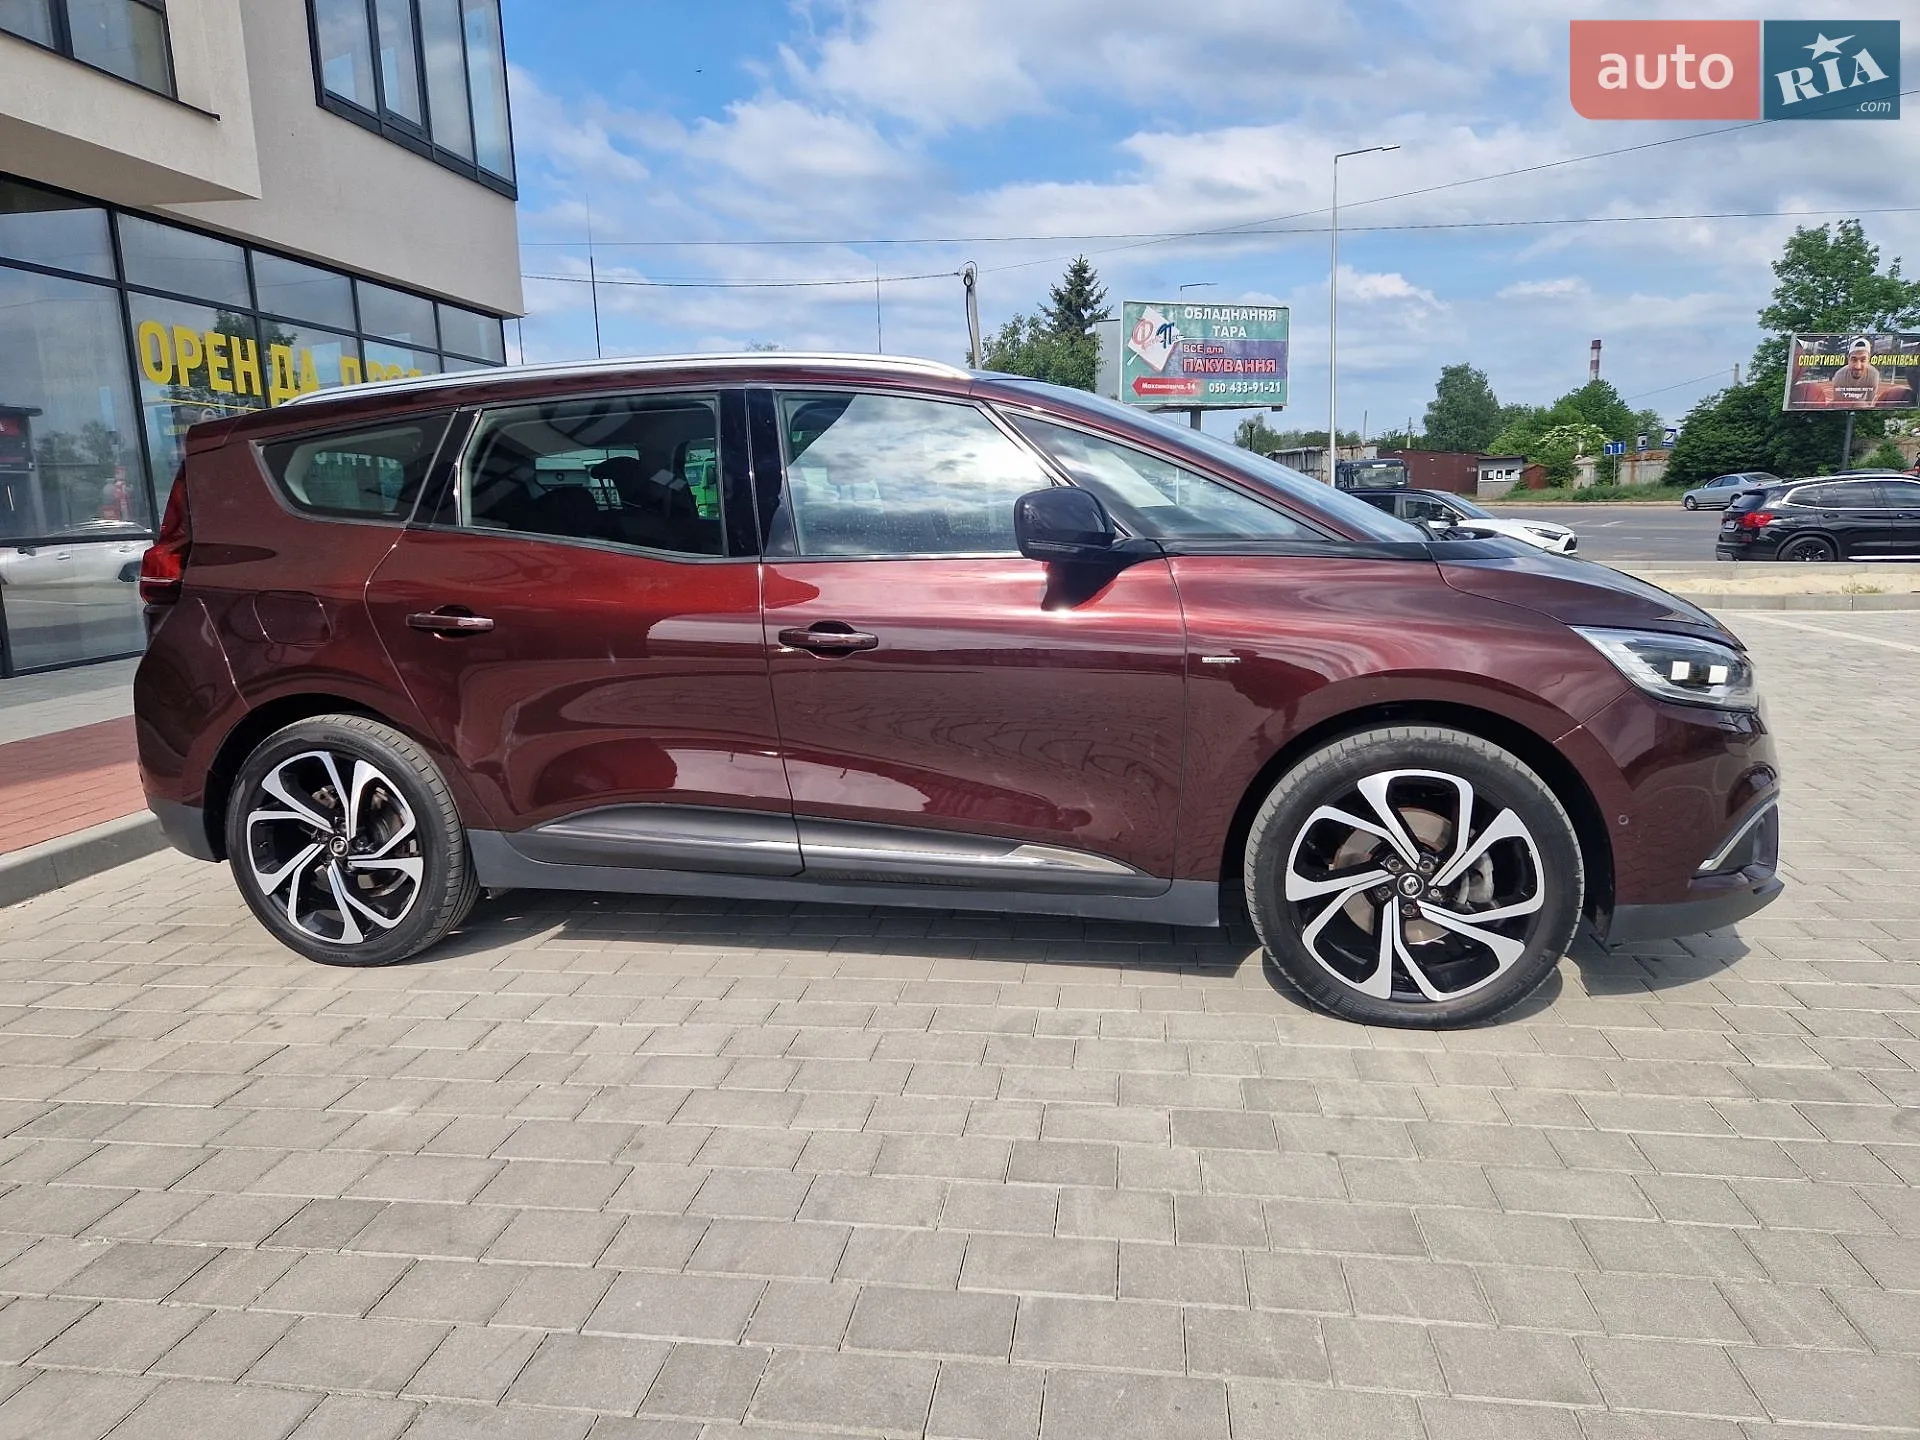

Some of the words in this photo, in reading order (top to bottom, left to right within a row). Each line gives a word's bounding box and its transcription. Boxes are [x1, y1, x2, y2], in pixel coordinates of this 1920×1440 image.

[1184, 306, 1277, 322] ОБЛАДНАННЯ
[1212, 325, 1248, 338] ТАРА
[1183, 344, 1204, 353] ВСЕ
[1206, 346, 1224, 354] для
[138, 320, 320, 407] ОРЕНДА
[1183, 358, 1276, 373] ПАКУВАННЯ
[1798, 354, 1846, 367] СПОРТИВНО
[1870, 354, 1920, 367] ФРАНКІВСЬК
[1209, 383, 1226, 393] 050
[1230, 382, 1281, 393] 433-91-21
